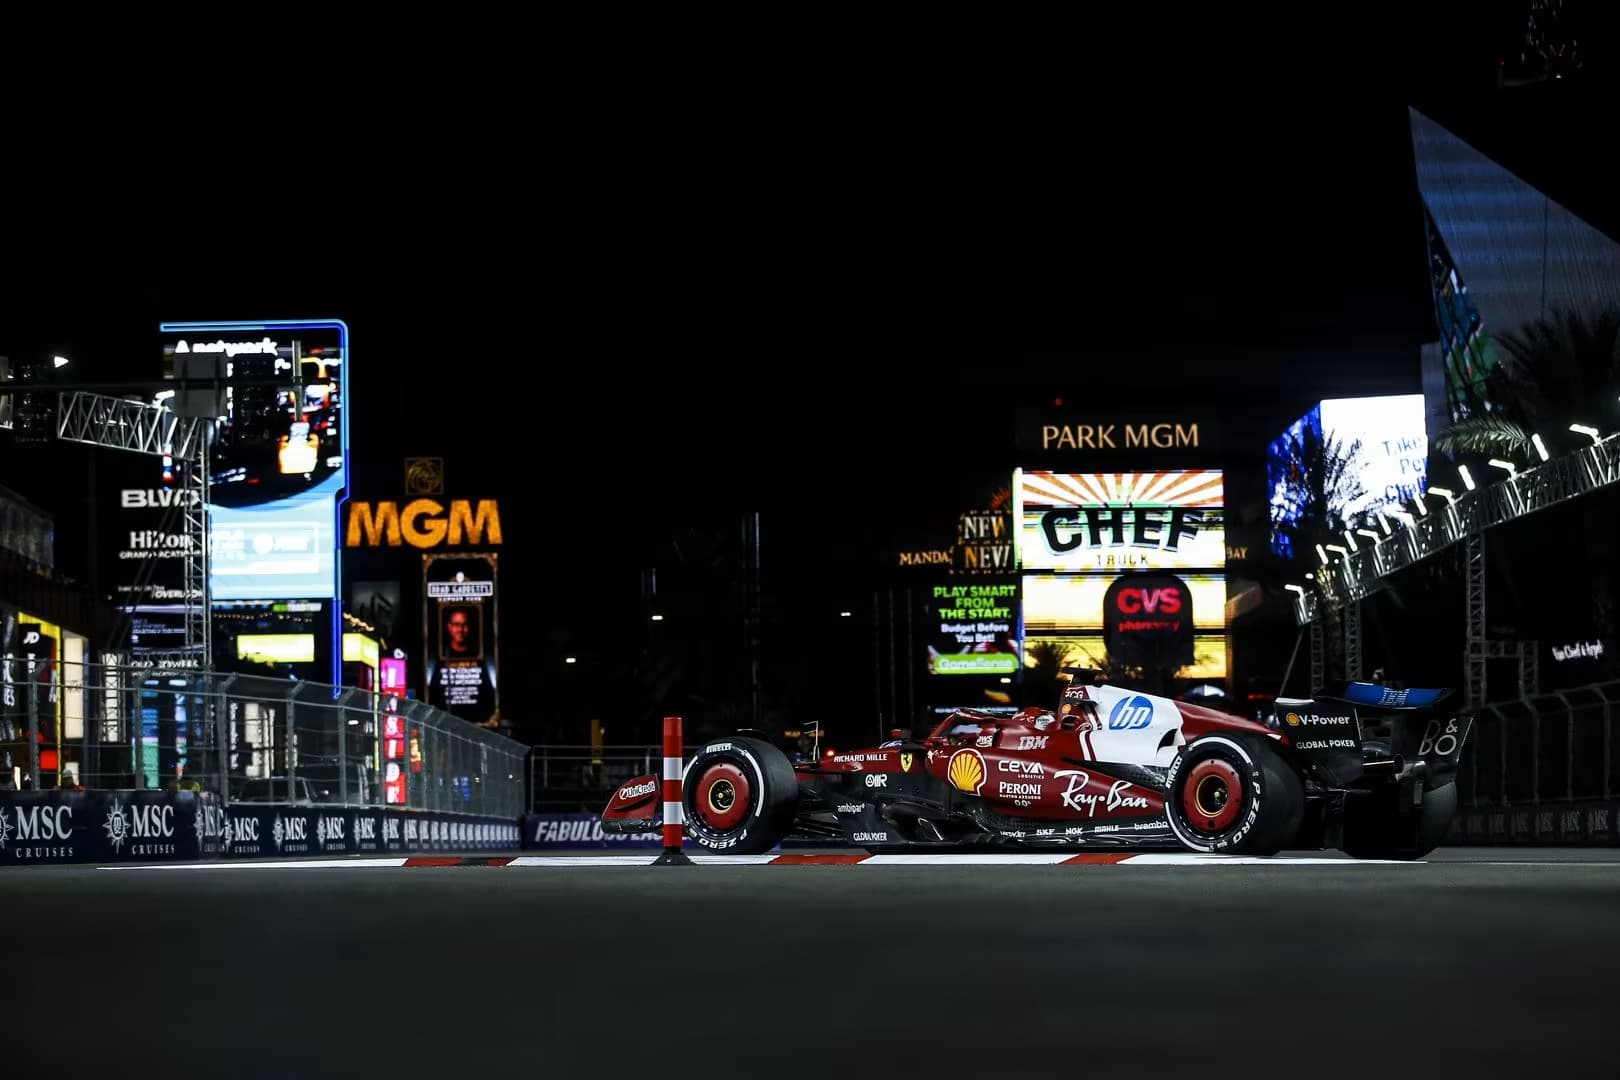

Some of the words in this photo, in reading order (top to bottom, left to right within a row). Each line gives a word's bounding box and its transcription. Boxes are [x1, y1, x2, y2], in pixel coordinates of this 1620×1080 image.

[1042, 424, 1117, 449] PARK
[1125, 423, 1199, 448] MGM
[346, 499, 503, 548] MGM
[1042, 505, 1204, 552] CHEF
[899, 550, 949, 566] MANDA
[933, 586, 968, 598] PLAY
[970, 585, 1016, 598] SMART
[956, 598, 994, 608] FROM
[1117, 587, 1182, 615] CVS
[938, 609, 965, 619] THE
[968, 608, 1012, 619] START.
[941, 624, 976, 634] Budget
[977, 623, 1009, 632] Before
[955, 634, 974, 643] You
[1109, 696, 1154, 730] hp
[1300, 714, 1350, 726] V-Power
[706, 742, 732, 754] PIRELLI
[1019, 735, 1050, 751] IBM
[1295, 740, 1328, 750] GLOBAL
[1329, 739, 1355, 748] POKER
[833, 754, 865, 763] RICHARD
[866, 753, 888, 761] MILLE
[626, 781, 656, 798] UniCredit
[999, 782, 1041, 795] PERONI
[836, 803, 864, 815] ambipar
[15, 806, 74, 840] MSC
[131, 804, 175, 838] MSC
[1134, 820, 1169, 830] brembo
[234, 817, 260, 841] MSC
[284, 817, 307, 840] MSC
[325, 817, 345, 840] MSC
[1036, 828, 1056, 836] SKF
[1065, 826, 1084, 836] NGK
[1094, 825, 1120, 833] MAHLE
[16, 846, 74, 858] CRUISES
[131, 844, 176, 855] CRUISES
